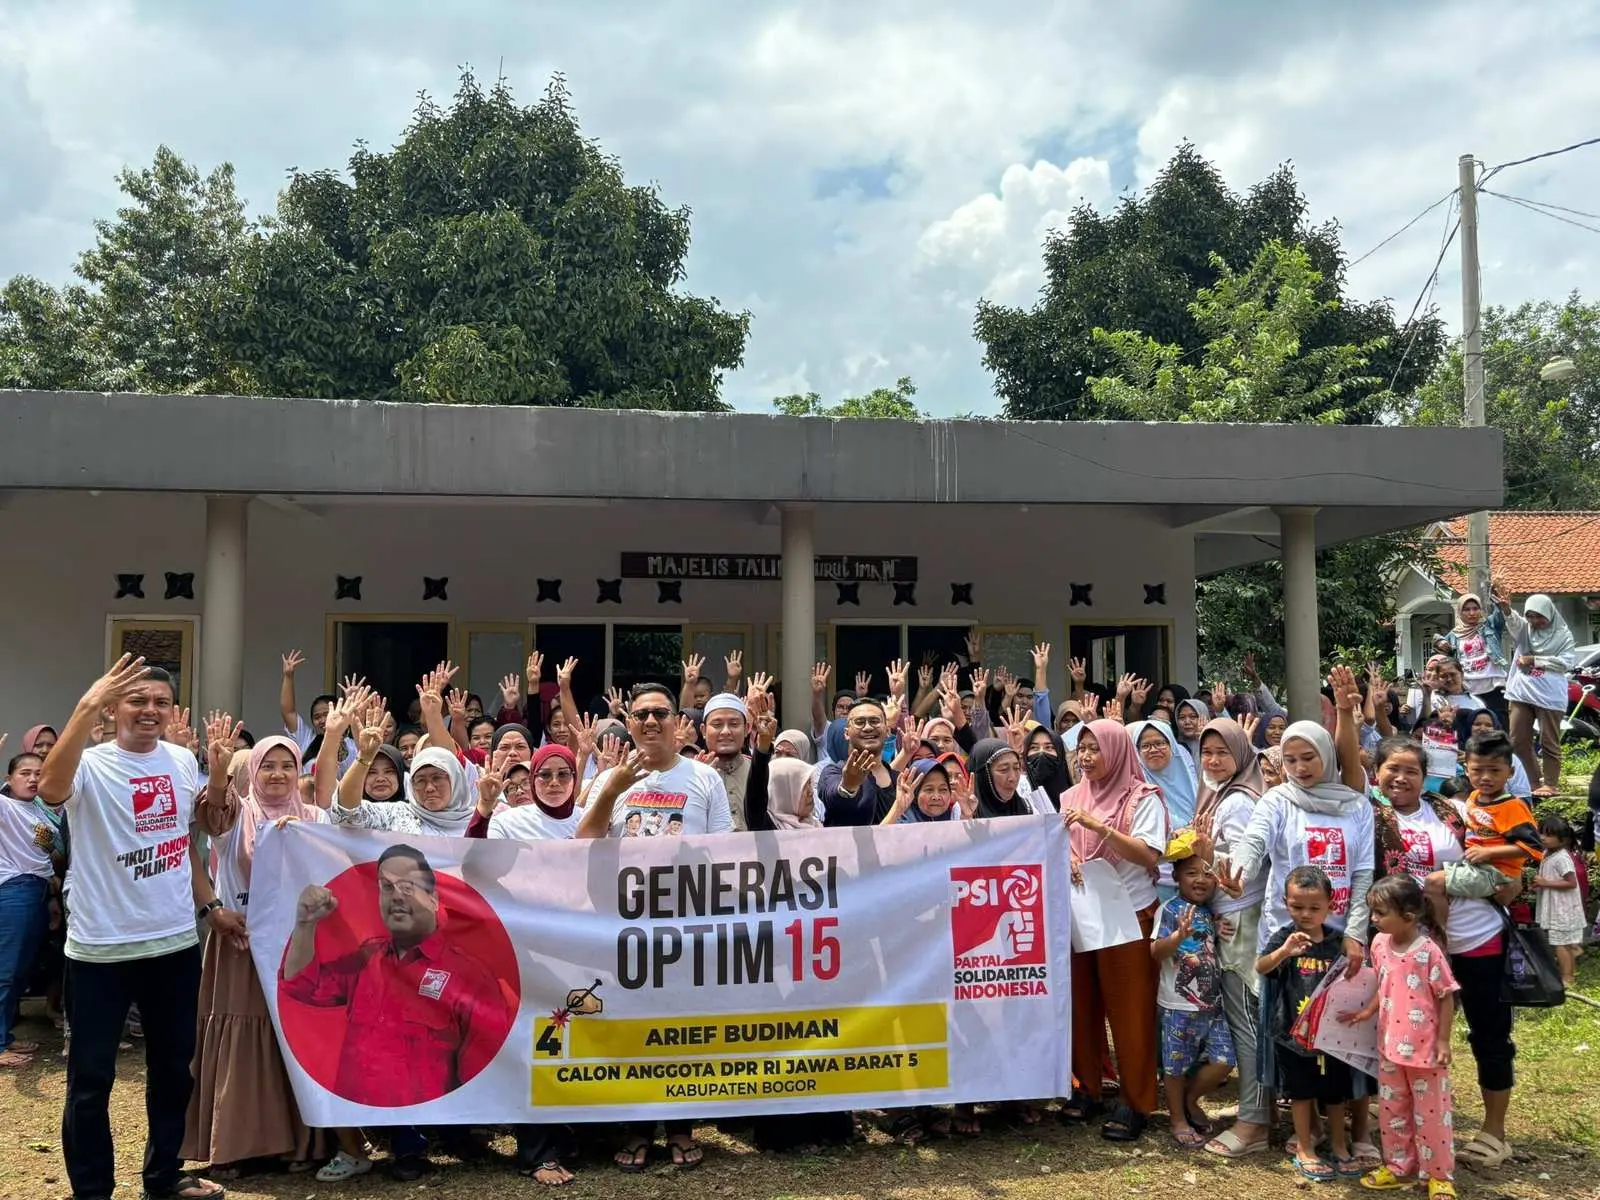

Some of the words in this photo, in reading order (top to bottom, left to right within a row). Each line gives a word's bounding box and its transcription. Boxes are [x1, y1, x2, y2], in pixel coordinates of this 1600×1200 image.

[648, 556, 729, 576] MAJELIS
[128, 782, 155, 794] PSI
[135, 821, 177, 833] INDONESIA
[133, 858, 166, 881] PILIH
[617, 856, 839, 920] GENERASI
[951, 879, 999, 907] PSI
[617, 920, 774, 990] OPTIM
[784, 917, 841, 982] 15
[954, 955, 1001, 969] PARTAI
[954, 966, 1047, 984] SOLIDARITAS
[954, 980, 1048, 1000] INDONESIA
[535, 1025, 562, 1056] 4
[645, 1025, 717, 1046] ARIEF
[724, 1018, 839, 1043] BUDIMAN
[557, 1066, 620, 1083] CALON
[625, 1062, 715, 1080] ANGGOTA
[720, 1060, 758, 1077] DPR
[763, 1060, 780, 1075] RI
[785, 1058, 839, 1075] JAWA
[844, 1054, 903, 1071] BARAT
[908, 1053, 918, 1067] 5
[666, 1082, 757, 1098] KABUPATEN
[762, 1079, 817, 1094] BOGOR
